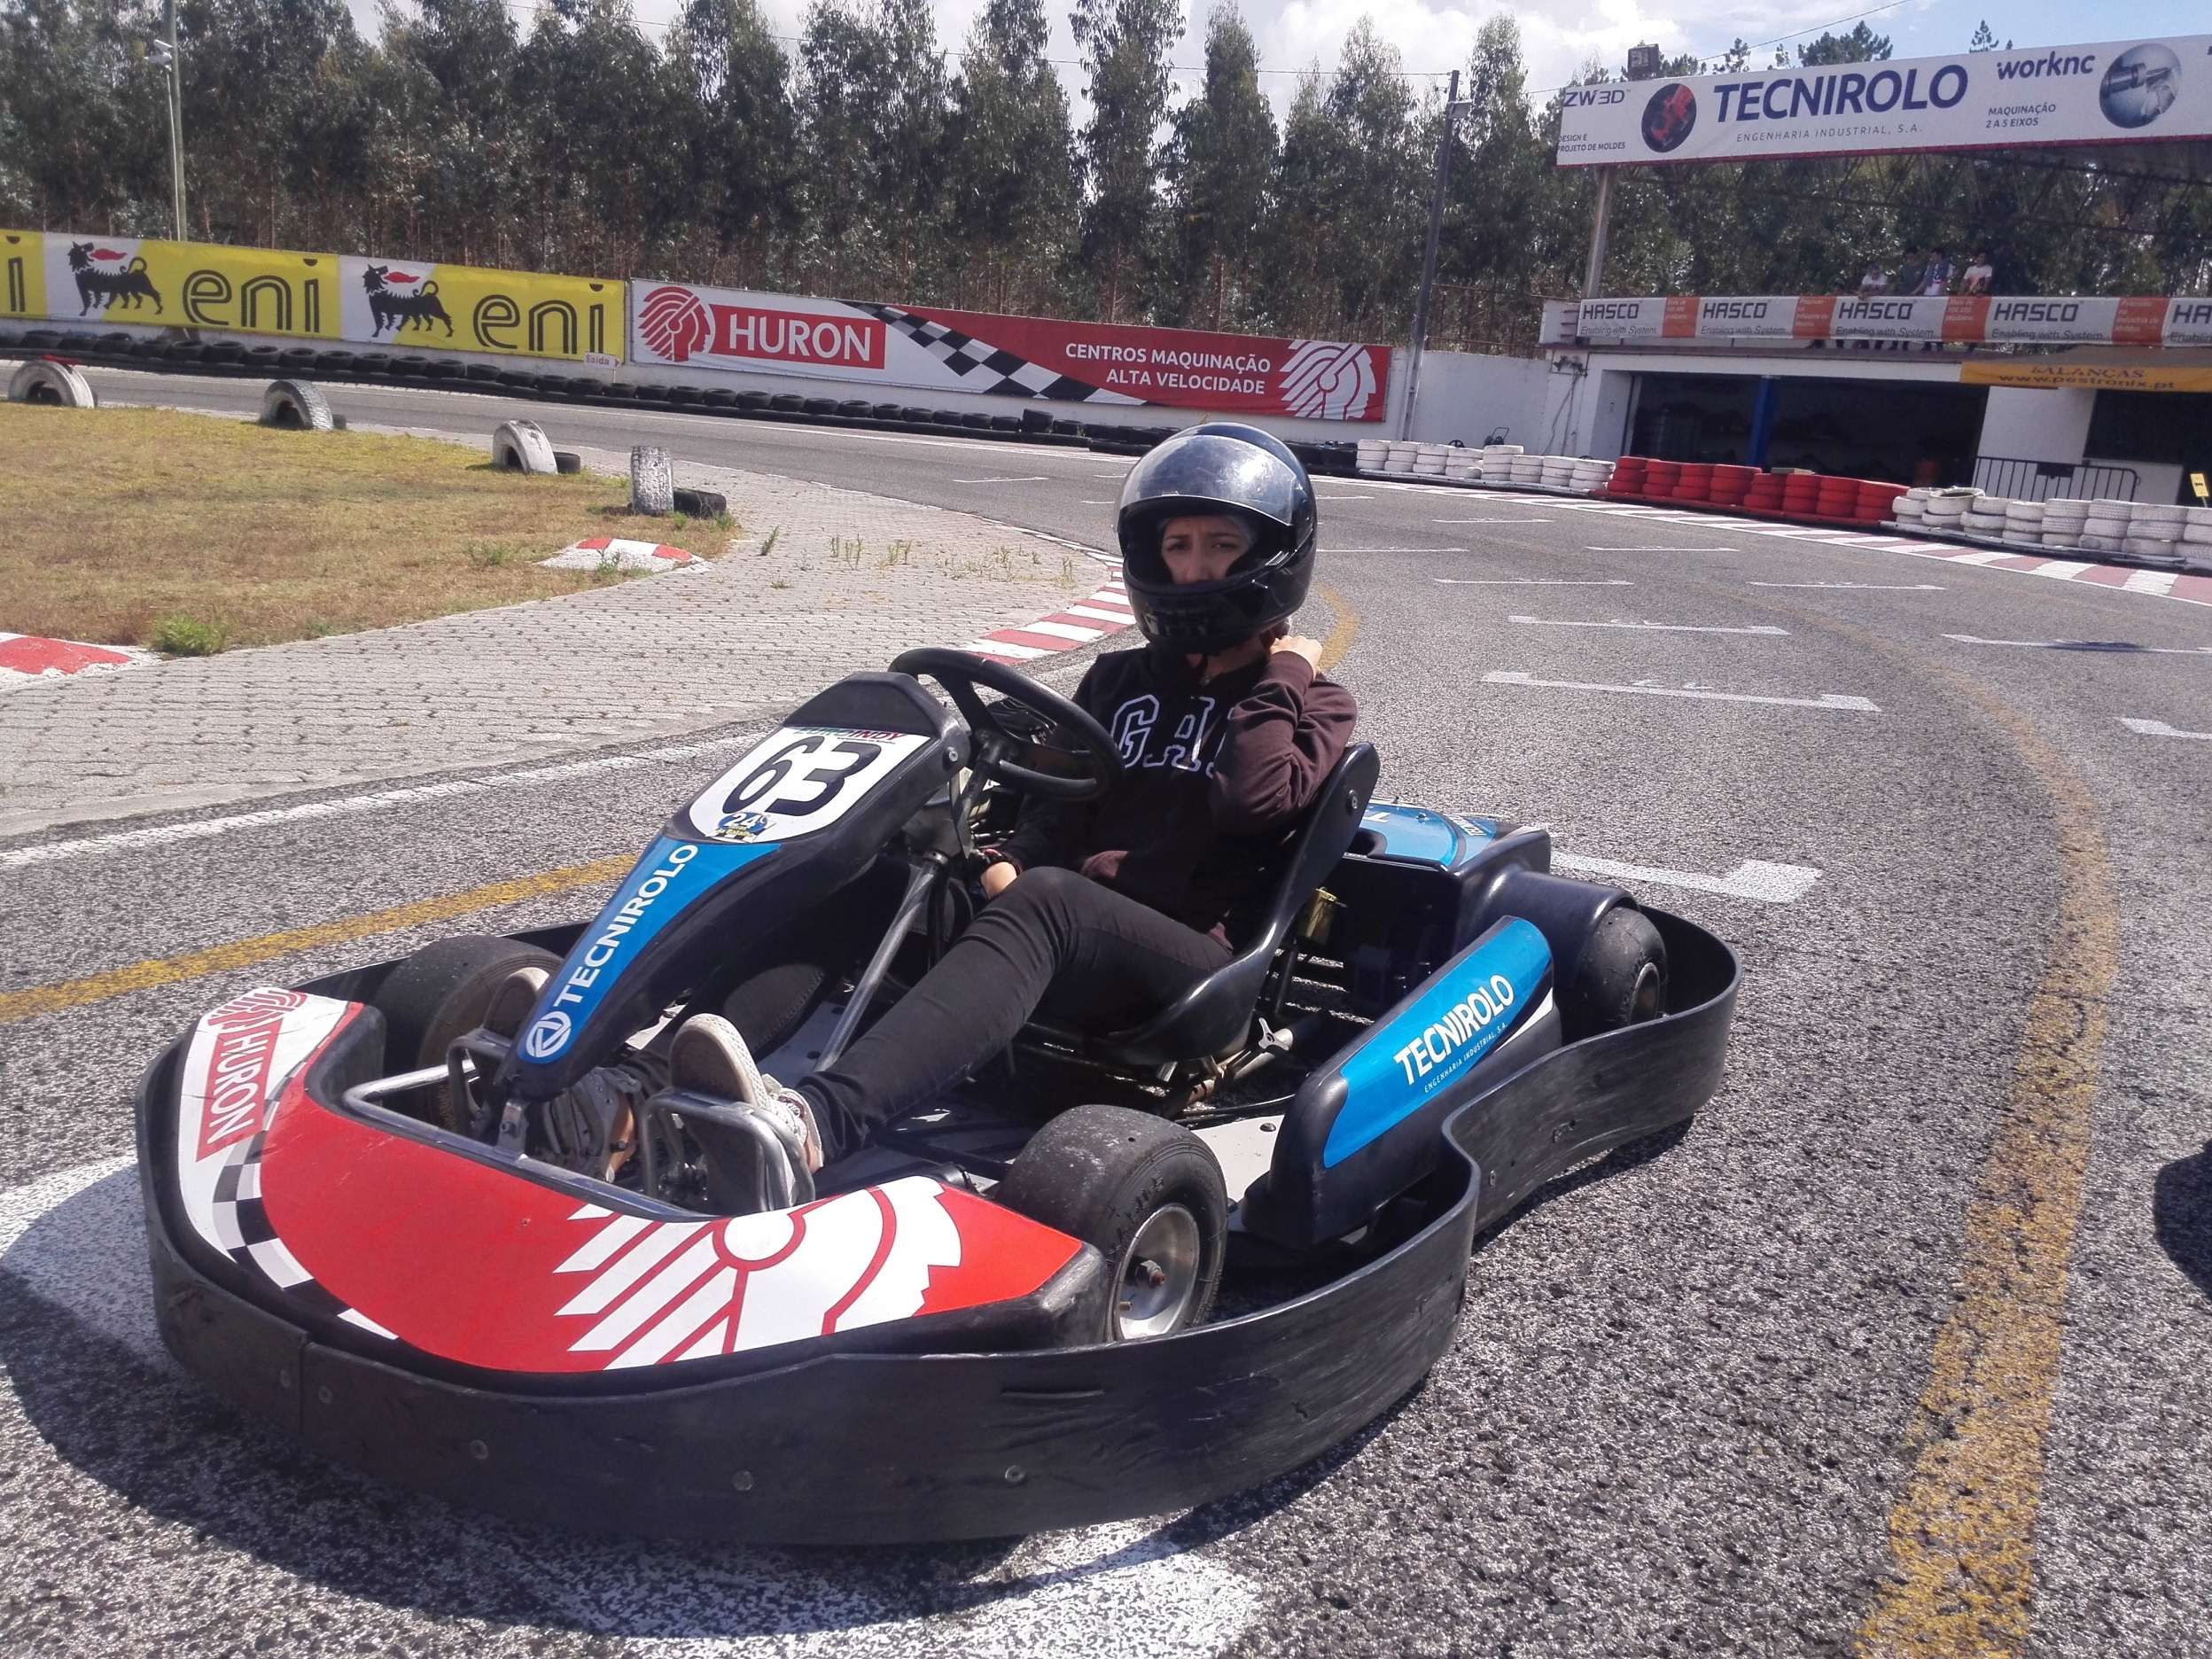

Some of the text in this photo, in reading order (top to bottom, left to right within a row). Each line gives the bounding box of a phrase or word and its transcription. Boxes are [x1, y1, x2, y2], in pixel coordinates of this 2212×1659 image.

[1997, 51, 2096, 81] worknc
[1714, 64, 1968, 122] TECNIROLO
[1985, 120, 1991, 129] 2
[2010, 117, 2039, 128] EIXOS
[1988, 104, 2056, 116] MAQUINAÇÃO
[1598, 141, 1626, 150] MOLDES
[1737, 129, 1810, 142] ENGENHARIA
[183, 257, 321, 333] eni
[1702, 302, 1768, 319] HASCO
[472, 283, 604, 354] eni
[1582, 303, 1640, 319] HASCO
[1838, 302, 1913, 320] HASCO
[1994, 303, 2080, 322] HASCO
[729, 313, 872, 362] HURON
[1065, 342, 1272, 375] CENTROS MAQUINAÇÃO
[1106, 368, 1266, 394] ALTA VELOCIDADE
[722, 735, 883, 816] 63
[552, 845, 699, 1007] TECNIROLO
[1393, 974, 1515, 1086] TECNIROLO
[207, 1030, 272, 1144] HURON
[1424, 1058, 1462, 1094] ENGENHARIA
